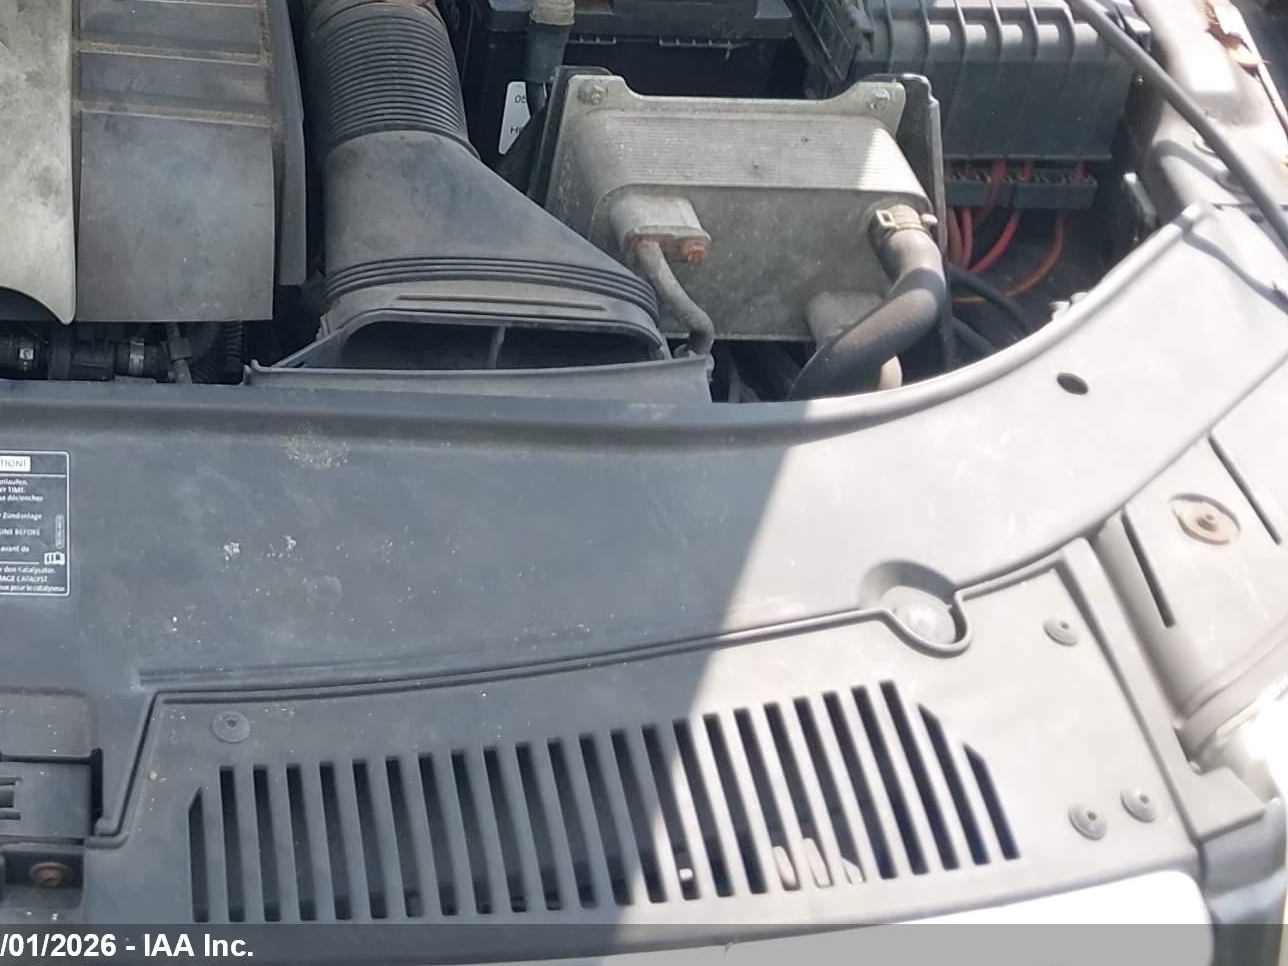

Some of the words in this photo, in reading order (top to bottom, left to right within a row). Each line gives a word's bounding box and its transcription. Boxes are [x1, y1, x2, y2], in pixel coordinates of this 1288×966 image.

[14, 528, 40, 536] BEFORE
[20, 545, 30, 553] de
[10, 585, 26, 593] pour
